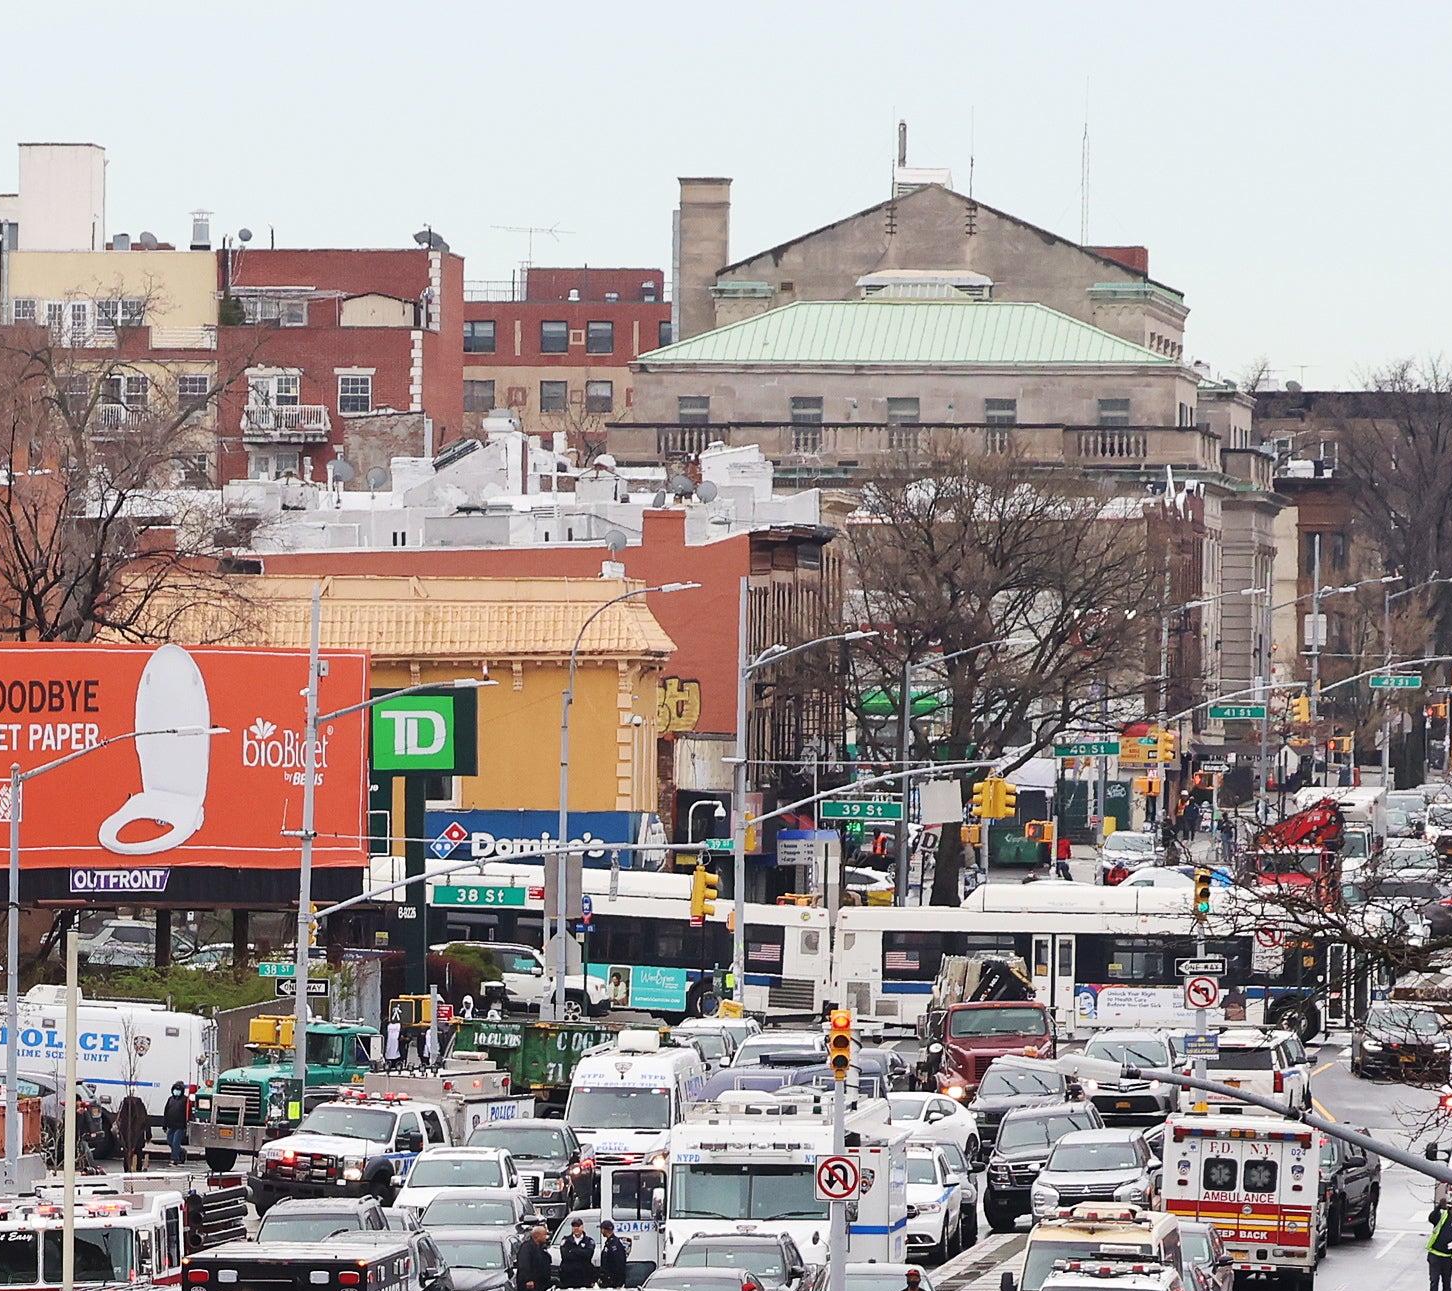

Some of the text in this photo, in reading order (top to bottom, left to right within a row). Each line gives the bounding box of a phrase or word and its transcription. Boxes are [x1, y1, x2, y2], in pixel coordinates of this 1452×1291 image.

[380, 709, 447, 755] TD
[842, 803, 883, 816] 39 St
[74, 869, 166, 890] OUTFRONT
[677, 1153, 700, 1162] NYPD
[1203, 1191, 1275, 1204] AMBULANCE
